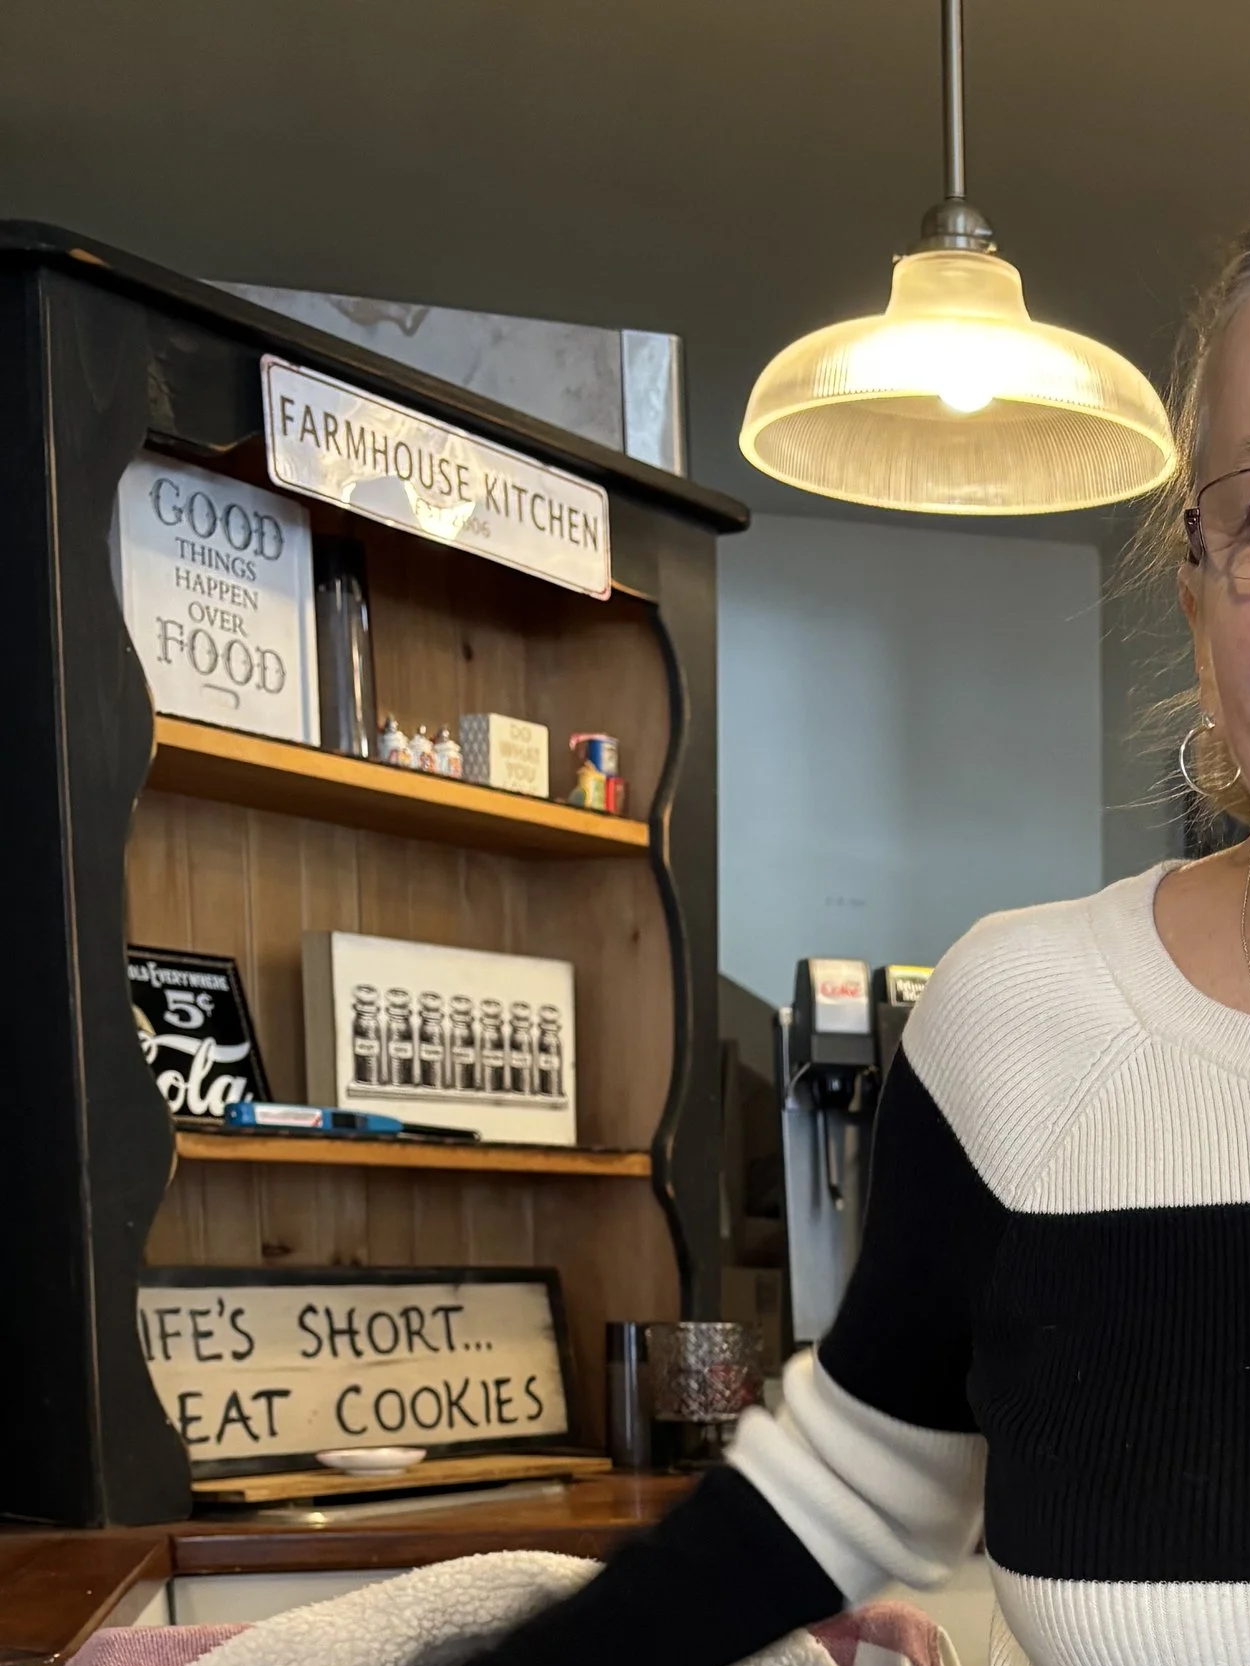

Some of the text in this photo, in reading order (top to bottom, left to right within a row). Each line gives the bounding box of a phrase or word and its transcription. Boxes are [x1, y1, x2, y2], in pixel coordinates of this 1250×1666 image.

[280, 395, 599, 552] FARMHOUSE KITCHEN
[149, 477, 285, 561] GOOD
[175, 536, 257, 582] THINGS
[175, 567, 259, 612] HAPPEN
[188, 601, 247, 638] OVER
[156, 616, 286, 694] FOOD
[139, 1297, 493, 1363] IFE'S SHORT...
[178, 1375, 543, 1445] EAT COOKIES
